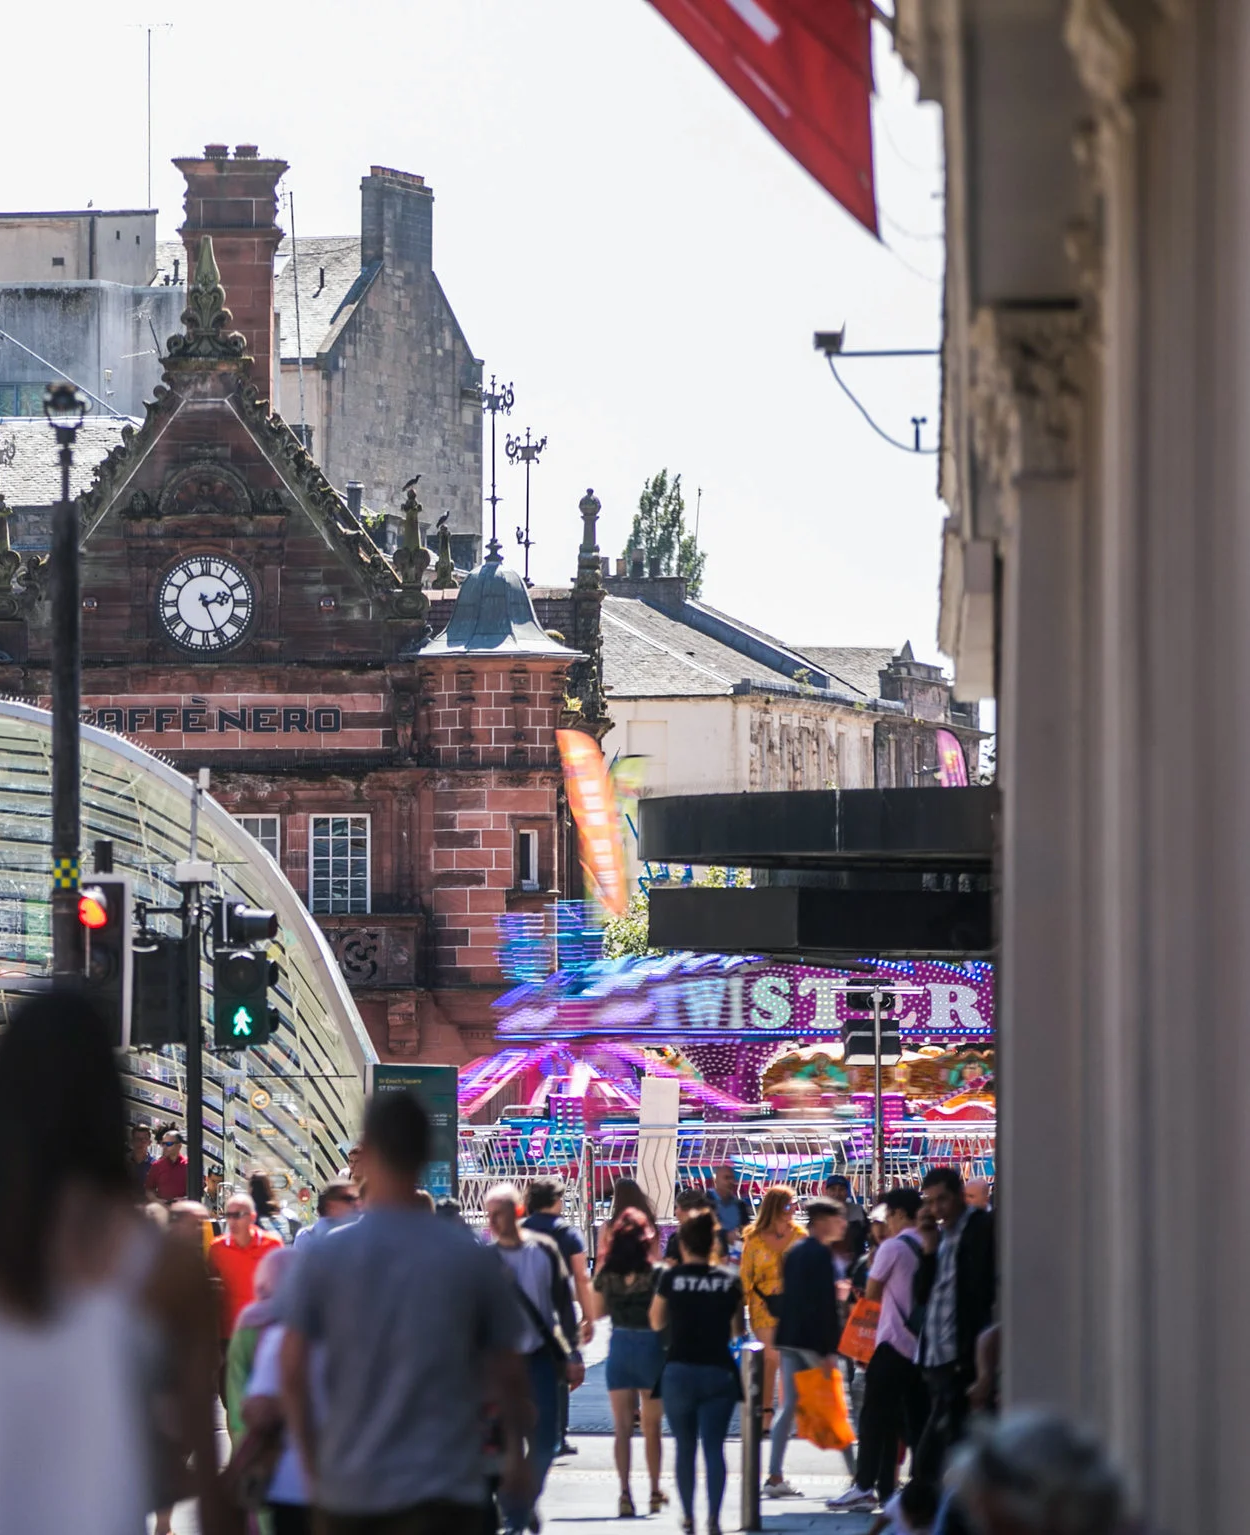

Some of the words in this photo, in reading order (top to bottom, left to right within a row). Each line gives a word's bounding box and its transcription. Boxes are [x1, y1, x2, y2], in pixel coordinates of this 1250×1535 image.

[79, 696, 208, 733] AFFÈ
[217, 706, 342, 733] NERO
[673, 1276, 732, 1293] STAFF
